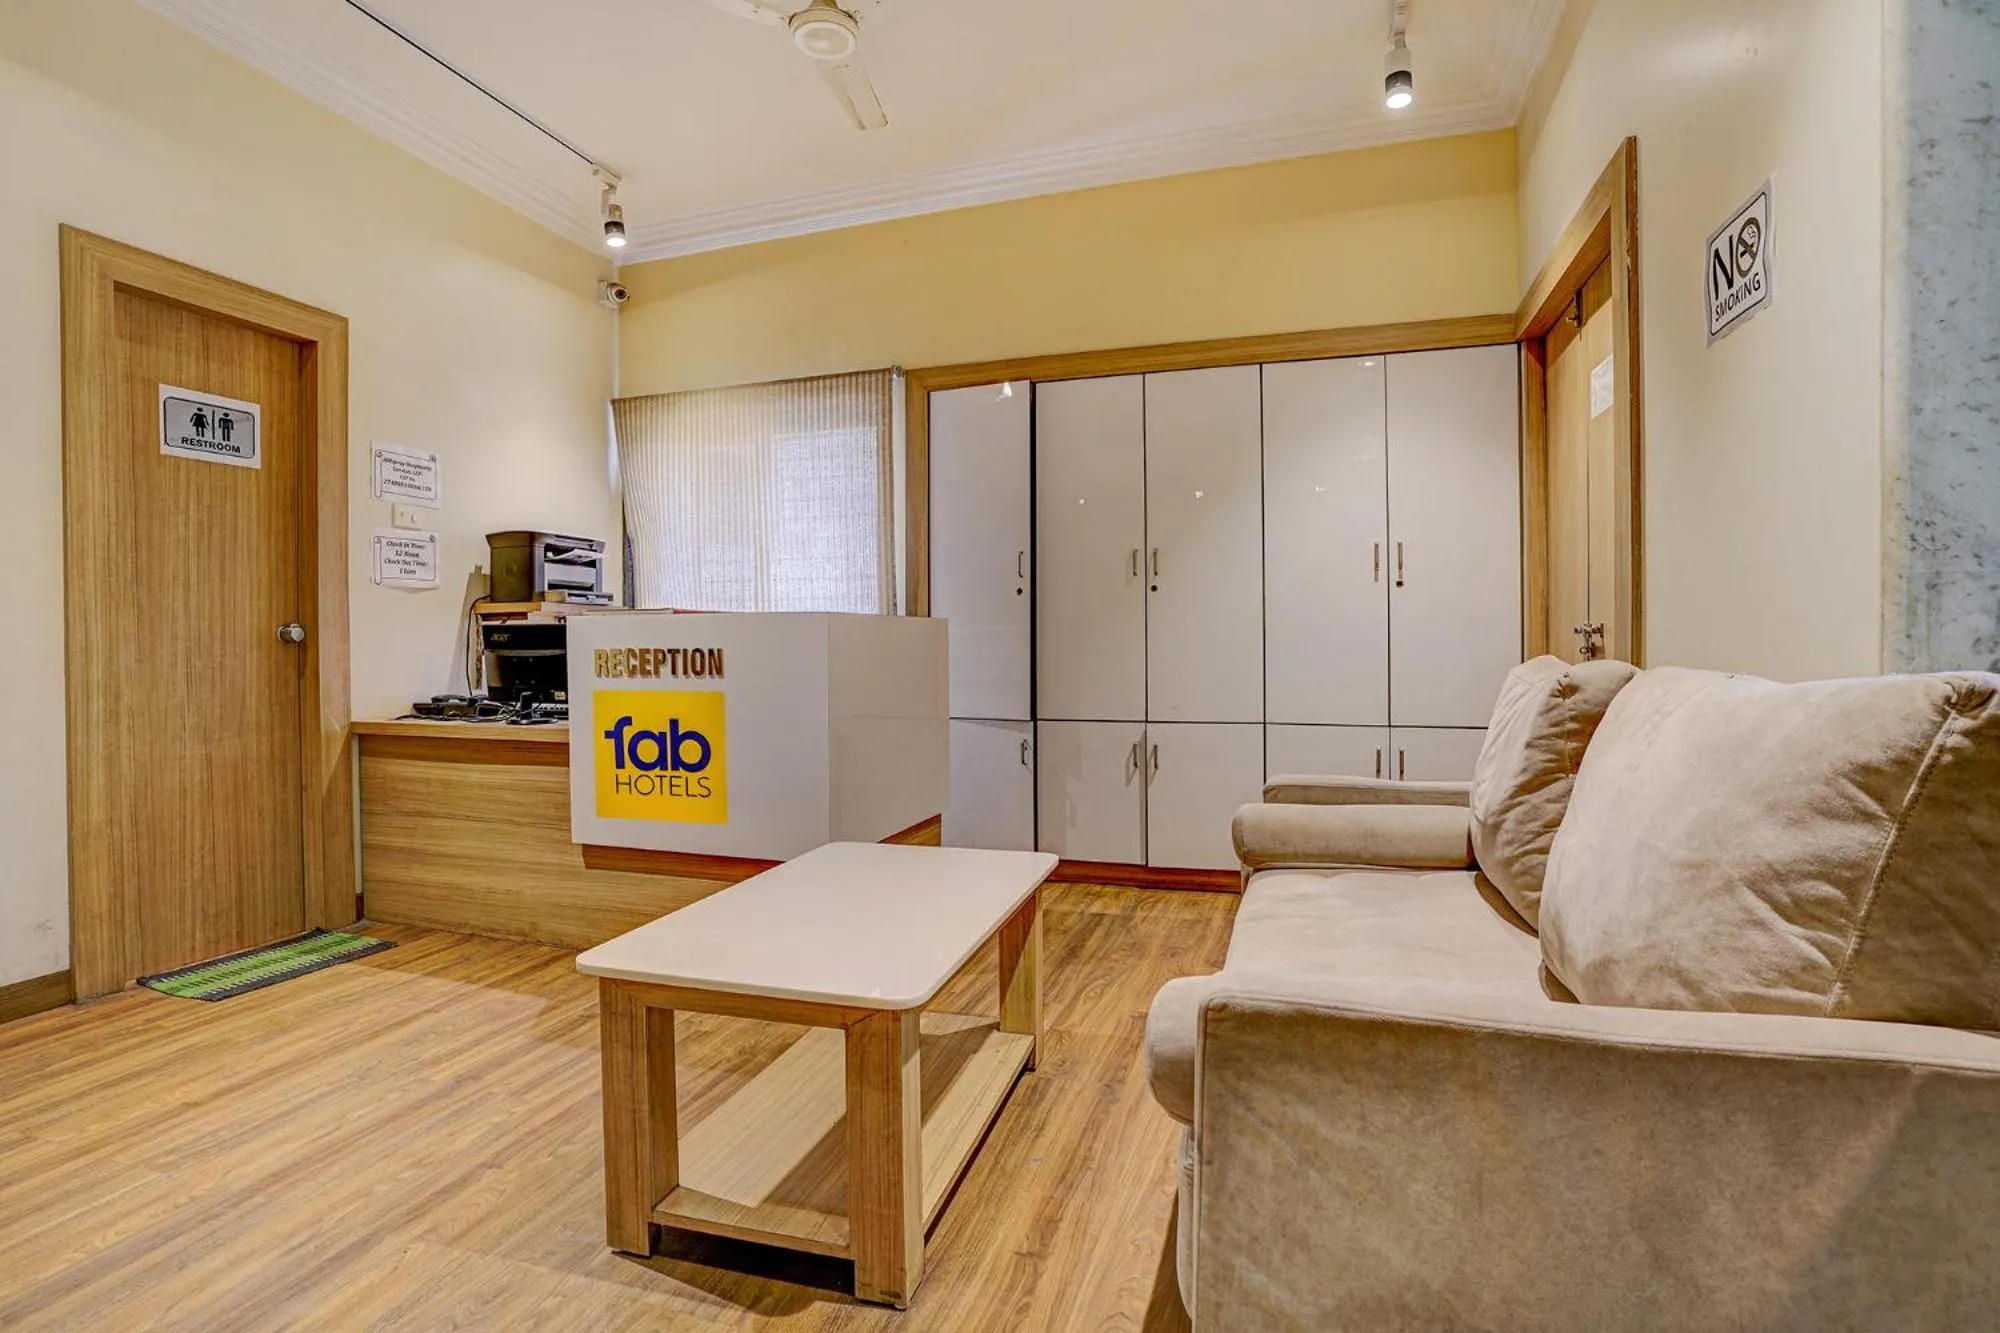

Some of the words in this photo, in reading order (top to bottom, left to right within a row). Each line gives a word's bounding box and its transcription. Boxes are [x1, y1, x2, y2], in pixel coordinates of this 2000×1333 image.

[1714, 272, 1761, 322] SMOKING
[181, 436, 241, 454] RESTROOM
[594, 648, 724, 679] RECEPTION
[604, 715, 712, 773] fab
[615, 774, 712, 798] HOTELS
